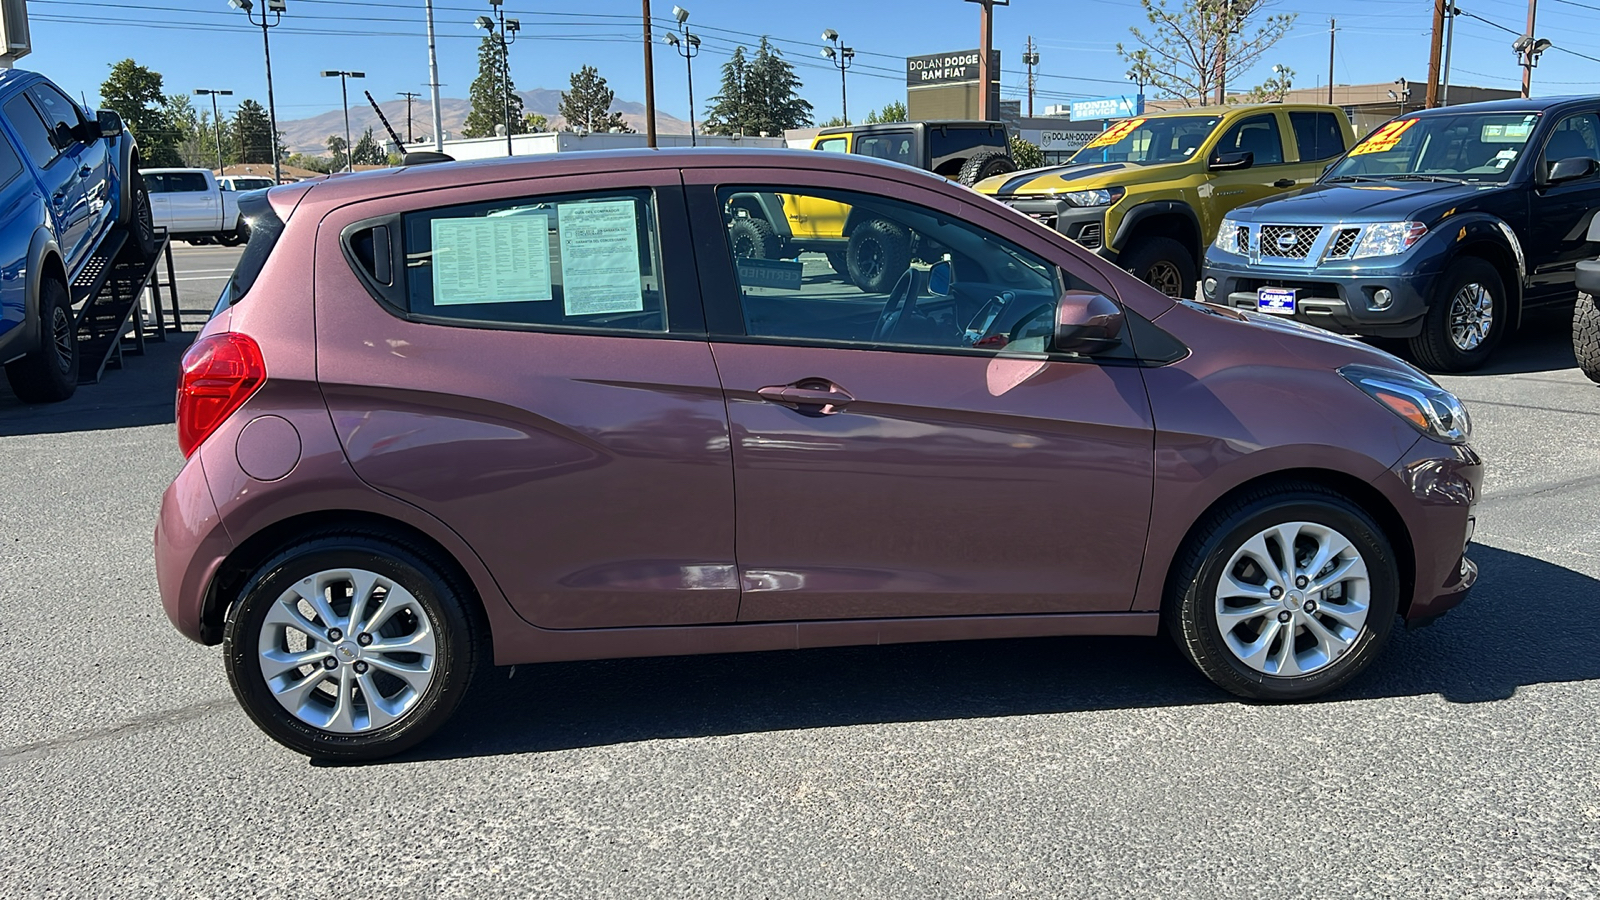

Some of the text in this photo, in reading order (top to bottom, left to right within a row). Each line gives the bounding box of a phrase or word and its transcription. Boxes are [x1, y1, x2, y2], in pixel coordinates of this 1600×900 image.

[909, 54, 978, 71] DOLAN DODGE
[921, 66, 966, 80] RAM FIAT
[1073, 100, 1118, 110] HONDA
[1076, 108, 1116, 117] SERVICE
[1365, 118, 1420, 142] 21
